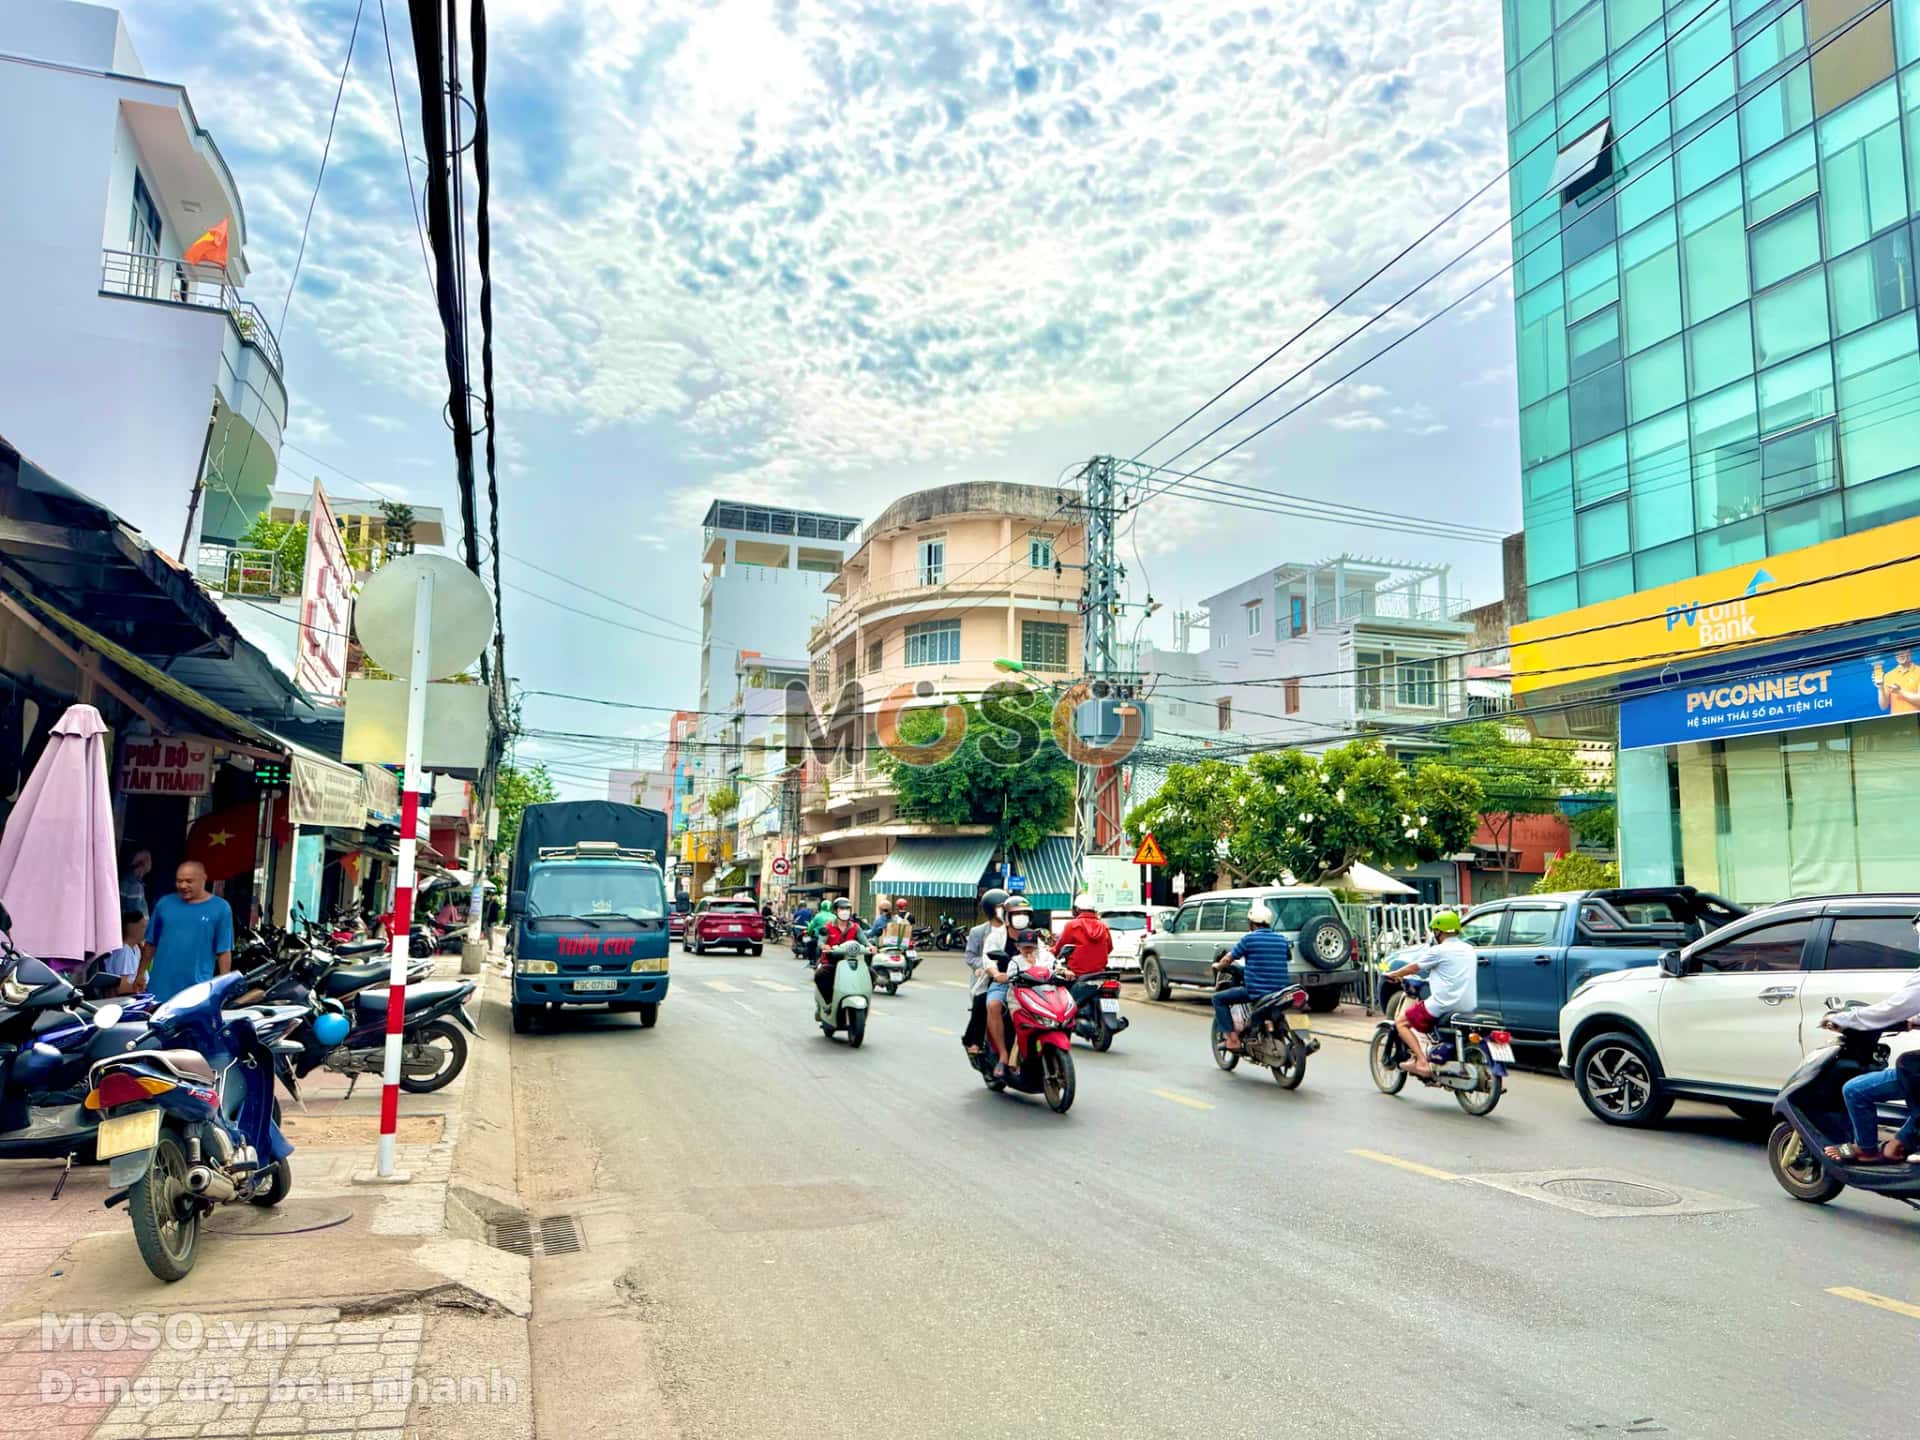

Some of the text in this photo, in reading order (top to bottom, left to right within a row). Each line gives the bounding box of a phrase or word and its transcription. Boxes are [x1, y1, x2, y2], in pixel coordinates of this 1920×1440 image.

[1699, 615, 1757, 648] Bank
[1686, 669, 1833, 714] PVCONNECT
[1686, 715, 1700, 728] HỆ
[1701, 714, 1725, 726] SINH
[1727, 709, 1750, 723] THÁI
[1768, 707, 1784, 717] ĐA
[1786, 701, 1811, 716] TIỆN
